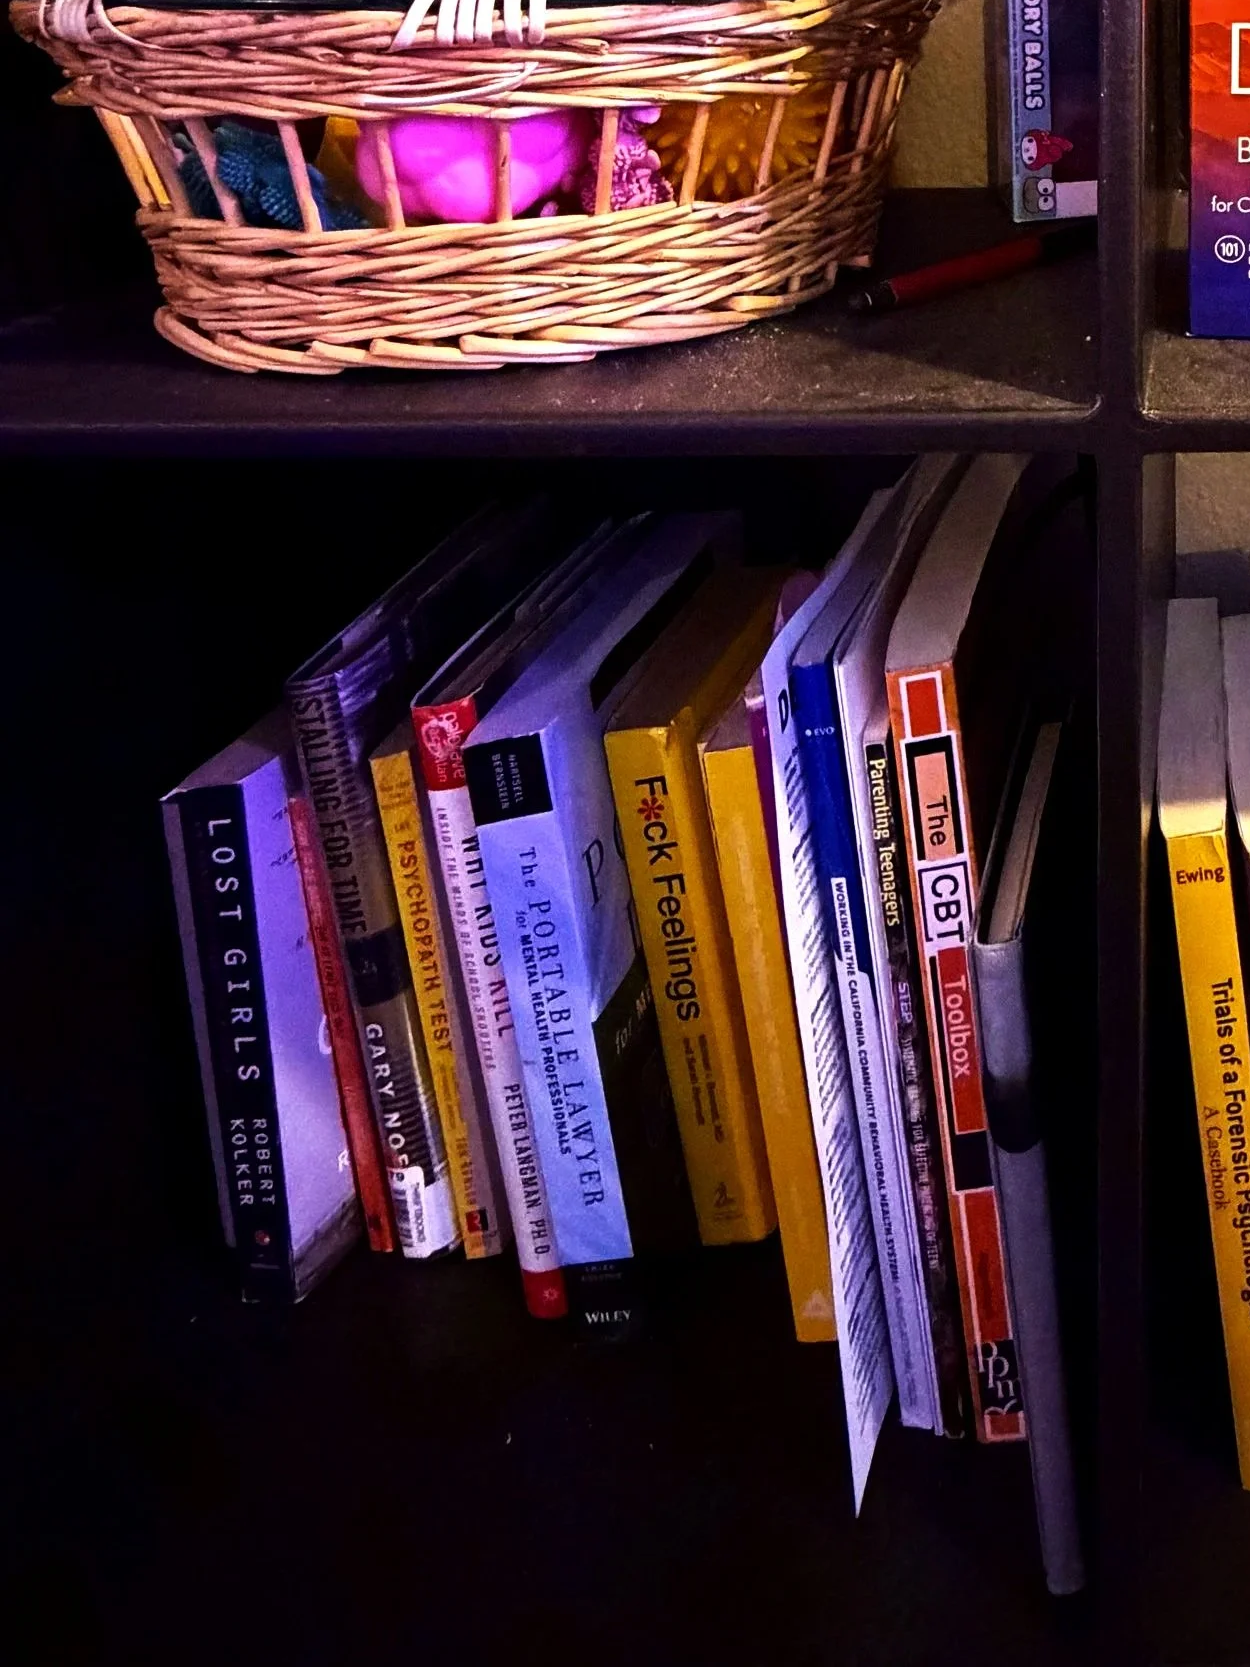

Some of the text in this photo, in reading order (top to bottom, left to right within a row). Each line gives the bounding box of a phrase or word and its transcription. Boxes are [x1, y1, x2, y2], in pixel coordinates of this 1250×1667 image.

[1023, 40, 1044, 110] BALLS
[1211, 196, 1234, 213] for
[1220, 240, 1239, 258] 101
[319, 818, 352, 870] FOR
[869, 758, 900, 927] Parenting Teenagers
[926, 795, 949, 847] The
[446, 856, 459, 878] THE
[1176, 867, 1225, 884] Ewing
[332, 875, 368, 934] TIME
[930, 874, 964, 942] CBT
[208, 819, 262, 1081] LOST GIRLS
[397, 839, 442, 993] PSYCHOPATH
[426, 998, 454, 1052] TEST
[653, 873, 701, 1022] Feelings
[519, 846, 605, 1207] The PORTABLE LAWYER
[898, 982, 913, 1023] STEP
[943, 975, 972, 1079] Toolbox
[1211, 978, 1237, 1038] Trials
[366, 1023, 396, 1098] GARY
[520, 935, 572, 1156] MENTAL HEALTH PROFESSIONALS
[835, 881, 892, 1236] WORKING THE CALIFORNIA COMMUNITY BEHAVIORAL HEALTH
[1219, 1044, 1242, 1065] of
[1223, 1071, 1238, 1084] a
[503, 1083, 527, 1135] PETER
[229, 1118, 254, 1206] KOLKER
[252, 1118, 275, 1205] ROBERT
[1204, 1106, 1232, 1211] A Casebook
[584, 1309, 632, 1326] WILEY
